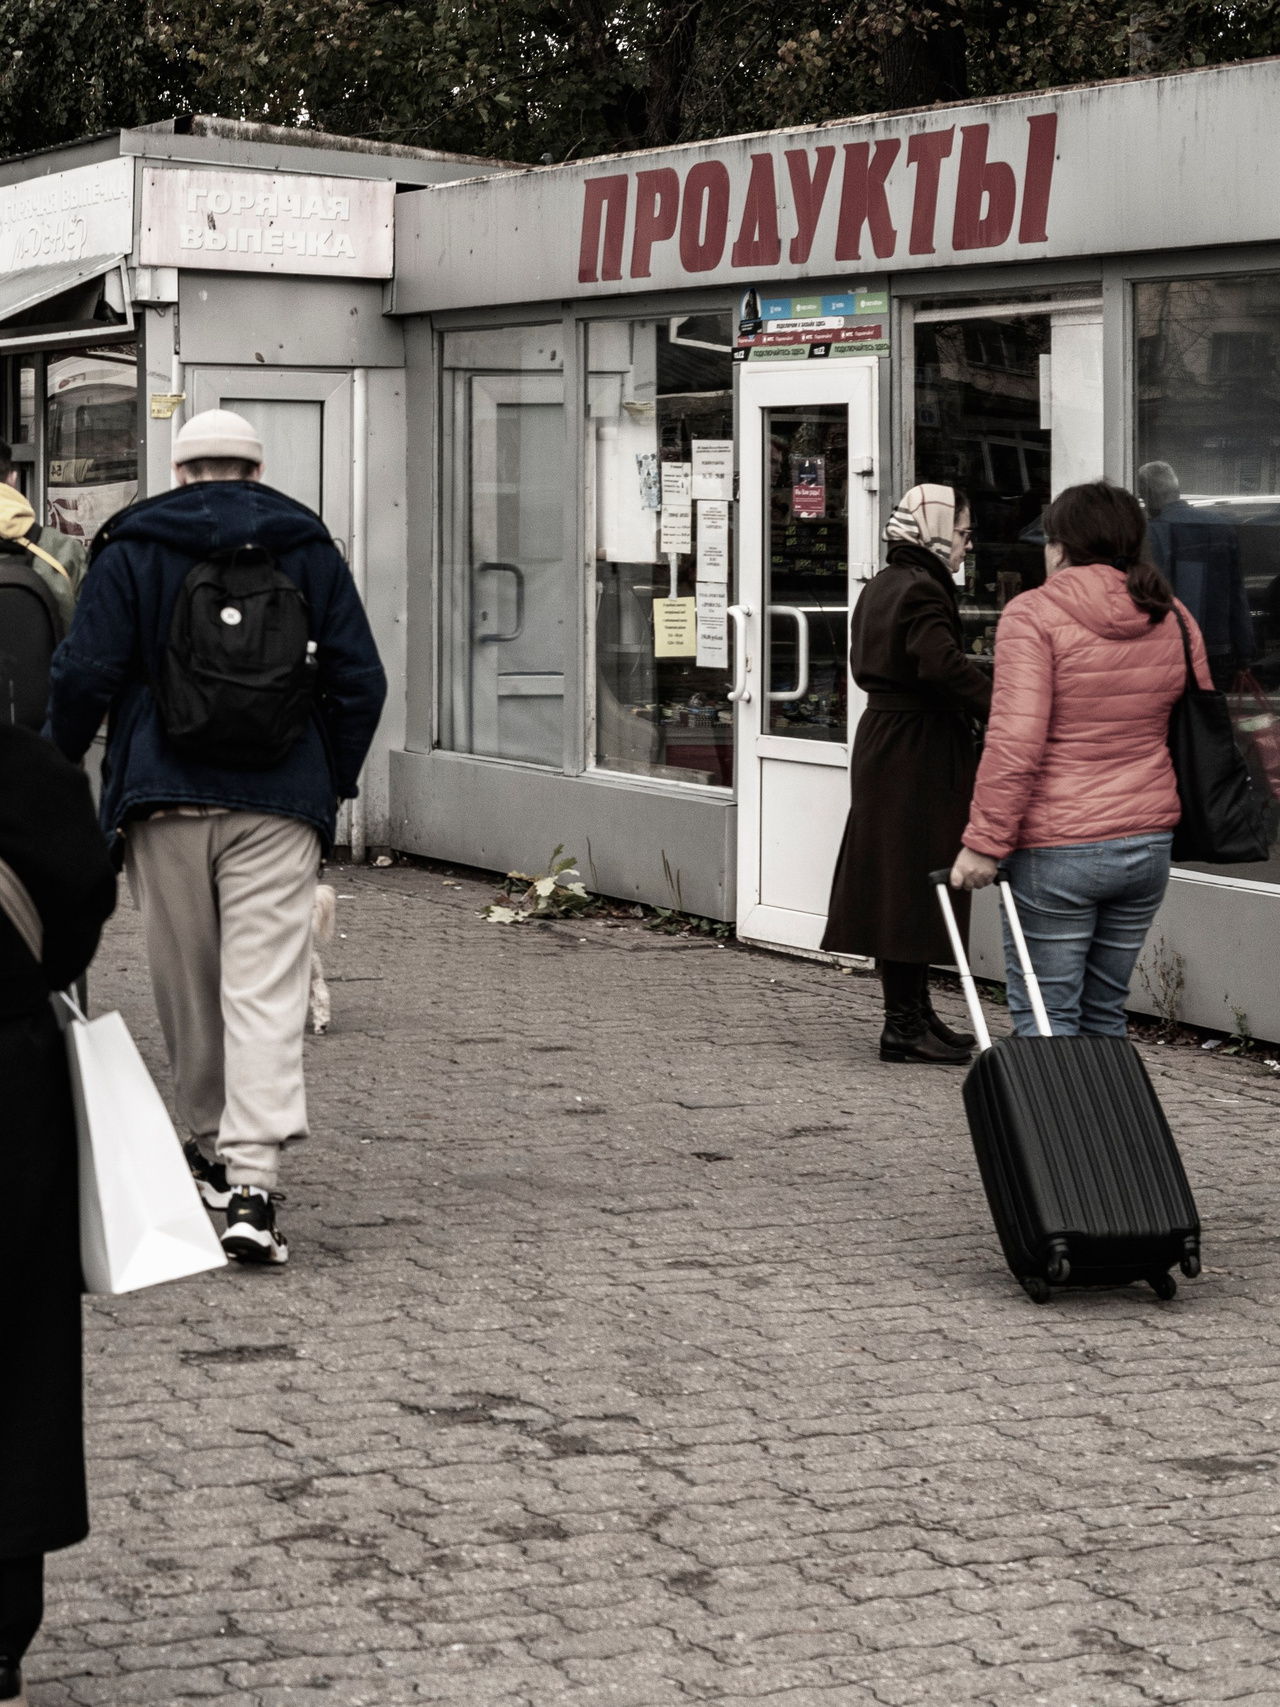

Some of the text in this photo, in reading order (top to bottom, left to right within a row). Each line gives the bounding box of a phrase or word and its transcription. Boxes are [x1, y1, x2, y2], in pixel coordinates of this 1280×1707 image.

[187, 188, 351, 222] ГОРЯЧАЯ
[577, 112, 1057, 283] ПРОДУКТЫ
[180, 224, 357, 259] ВЫПЕЧКА
